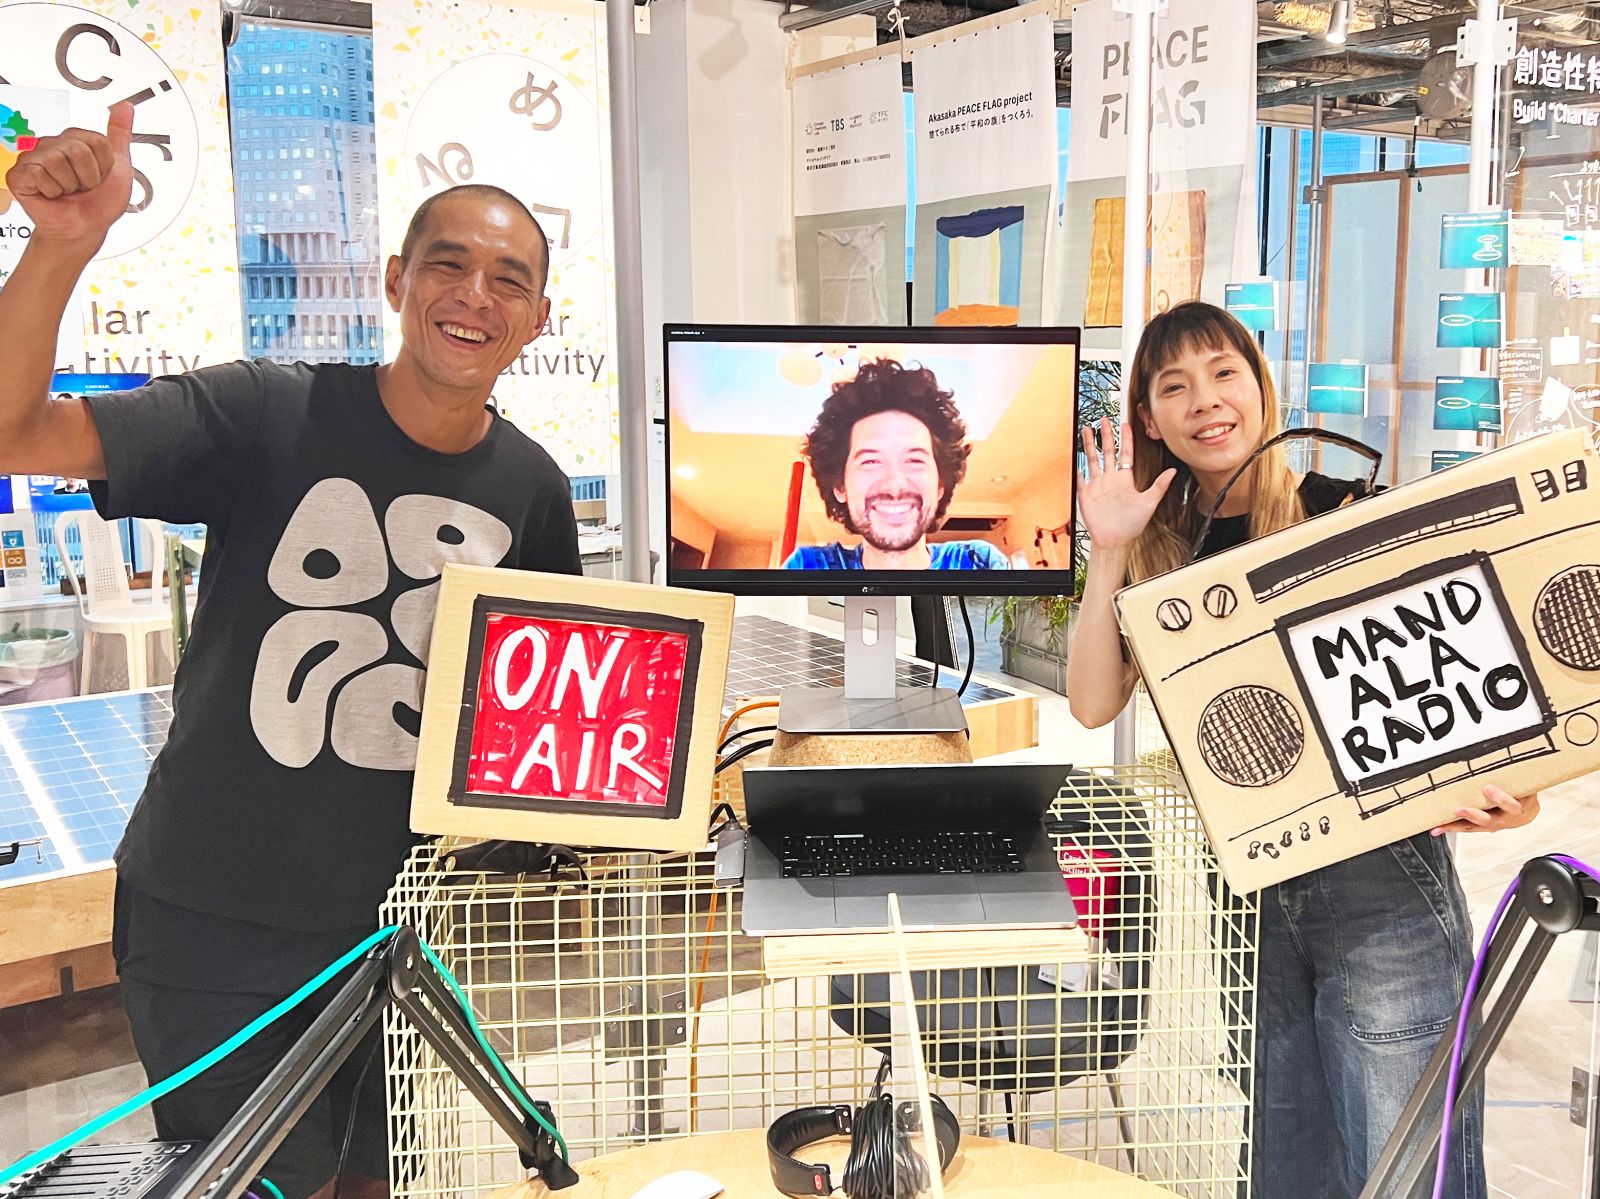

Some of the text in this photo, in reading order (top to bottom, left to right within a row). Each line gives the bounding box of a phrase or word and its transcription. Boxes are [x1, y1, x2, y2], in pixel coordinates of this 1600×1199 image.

[831, 118, 845, 131] TBS
[928, 91, 1033, 123] Akasaka PEACE FLAG project
[1100, 80, 1206, 139] FAG
[1513, 99, 1546, 122] Build
[1312, 577, 1482, 679] MAND
[494, 625, 625, 719] ON
[1350, 633, 1480, 721] ALA
[1342, 663, 1529, 772] RADIO
[510, 722, 664, 792] AIR
